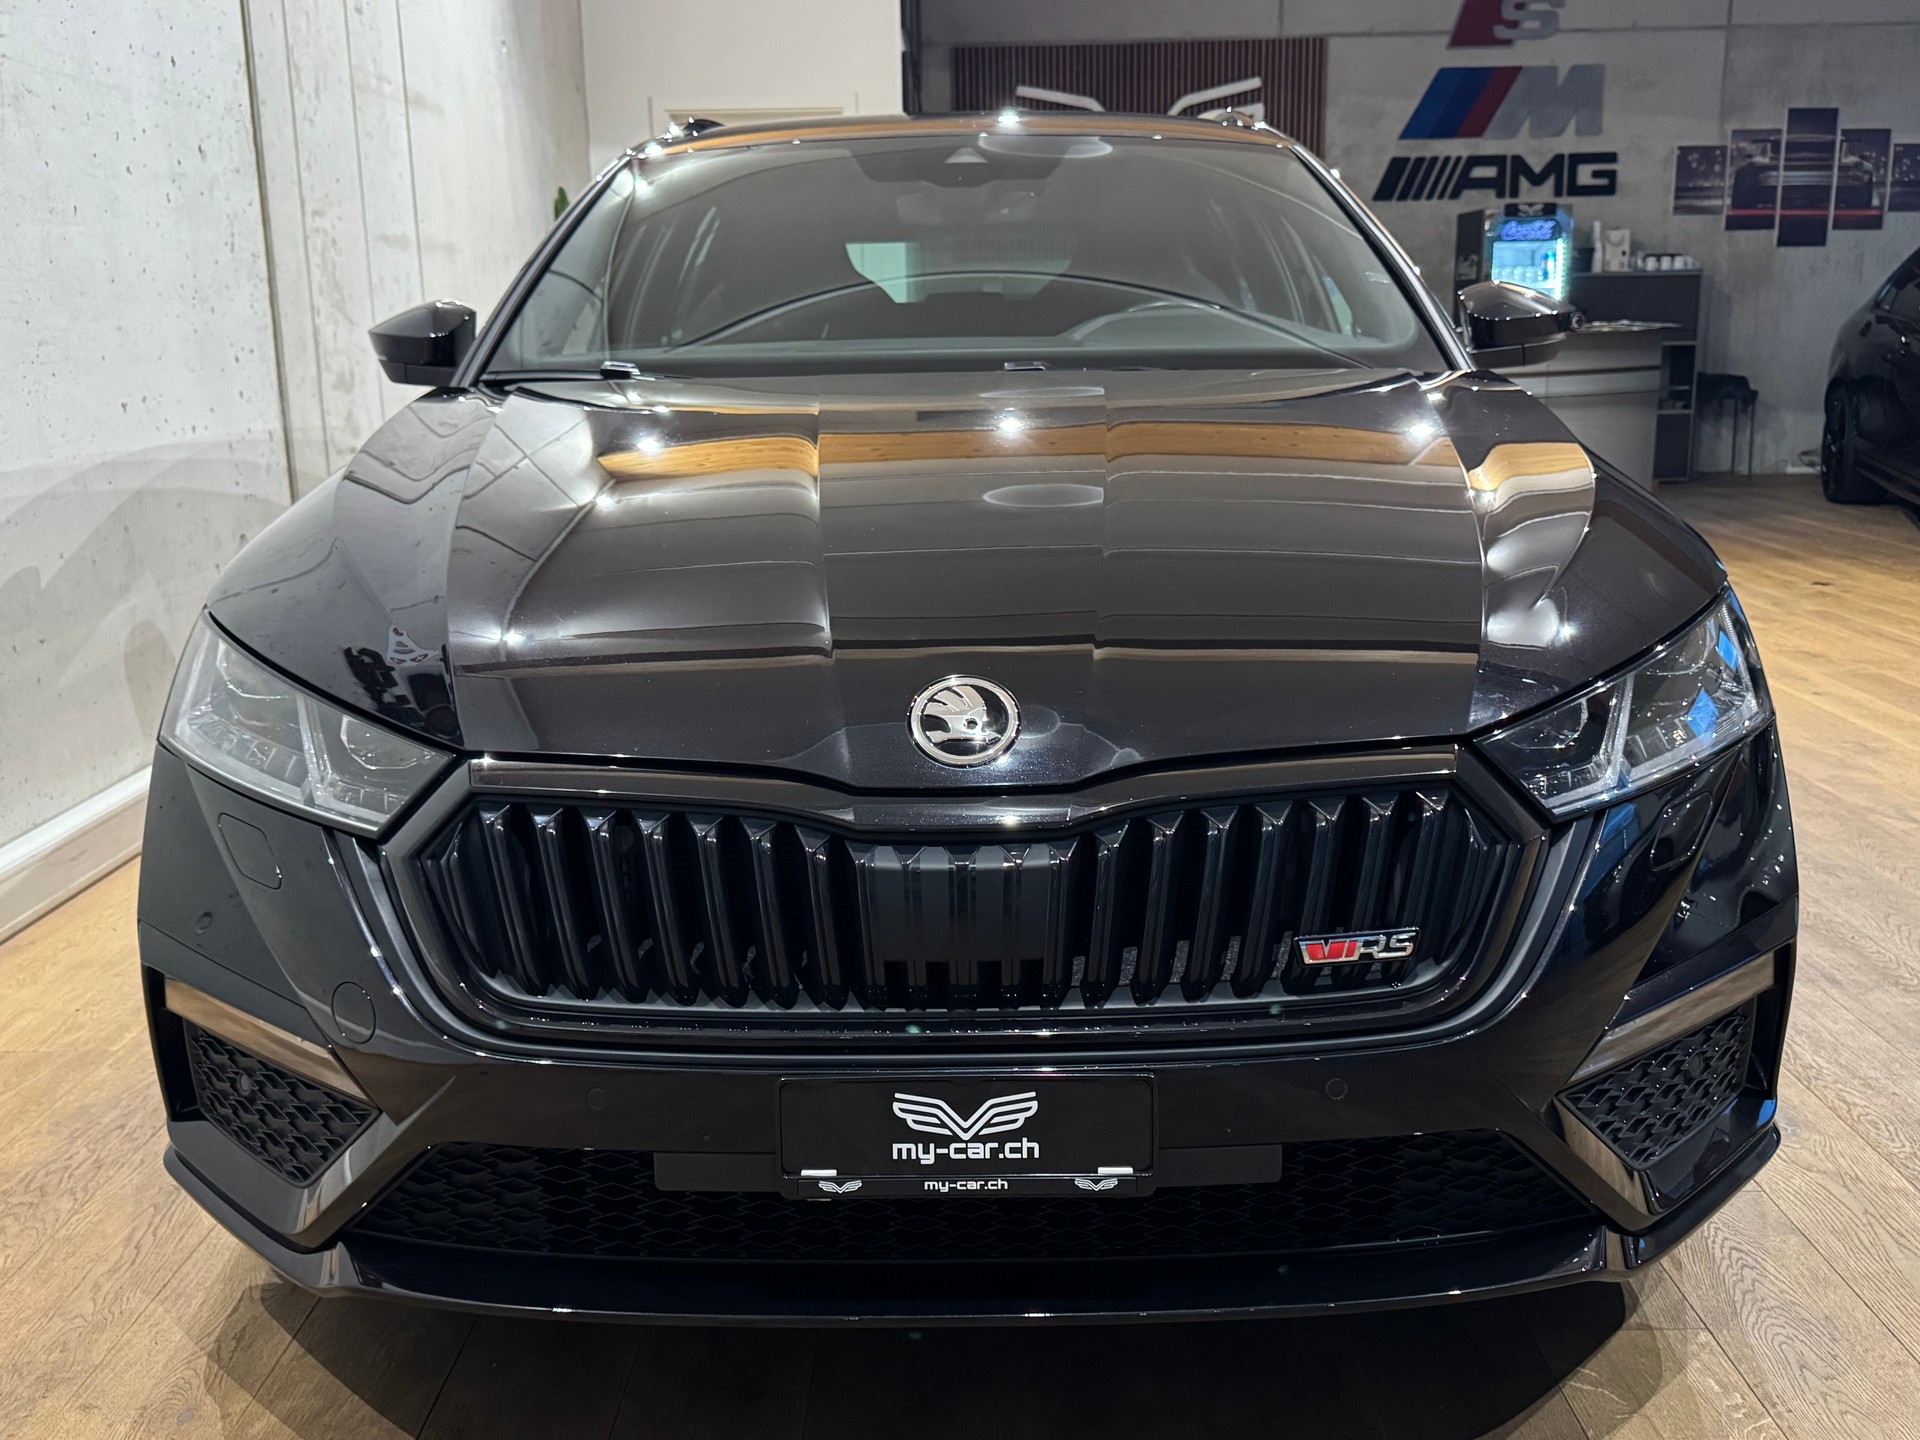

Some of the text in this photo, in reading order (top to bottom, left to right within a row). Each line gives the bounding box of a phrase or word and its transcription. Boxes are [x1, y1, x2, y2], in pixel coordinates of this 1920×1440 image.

[1493, 0, 1566, 40] S
[1483, 64, 1605, 139] M
[1448, 152, 1618, 200] AMG
[892, 1137, 1040, 1165] my-car.ch
[924, 1178, 1009, 1193] my-car.ch
